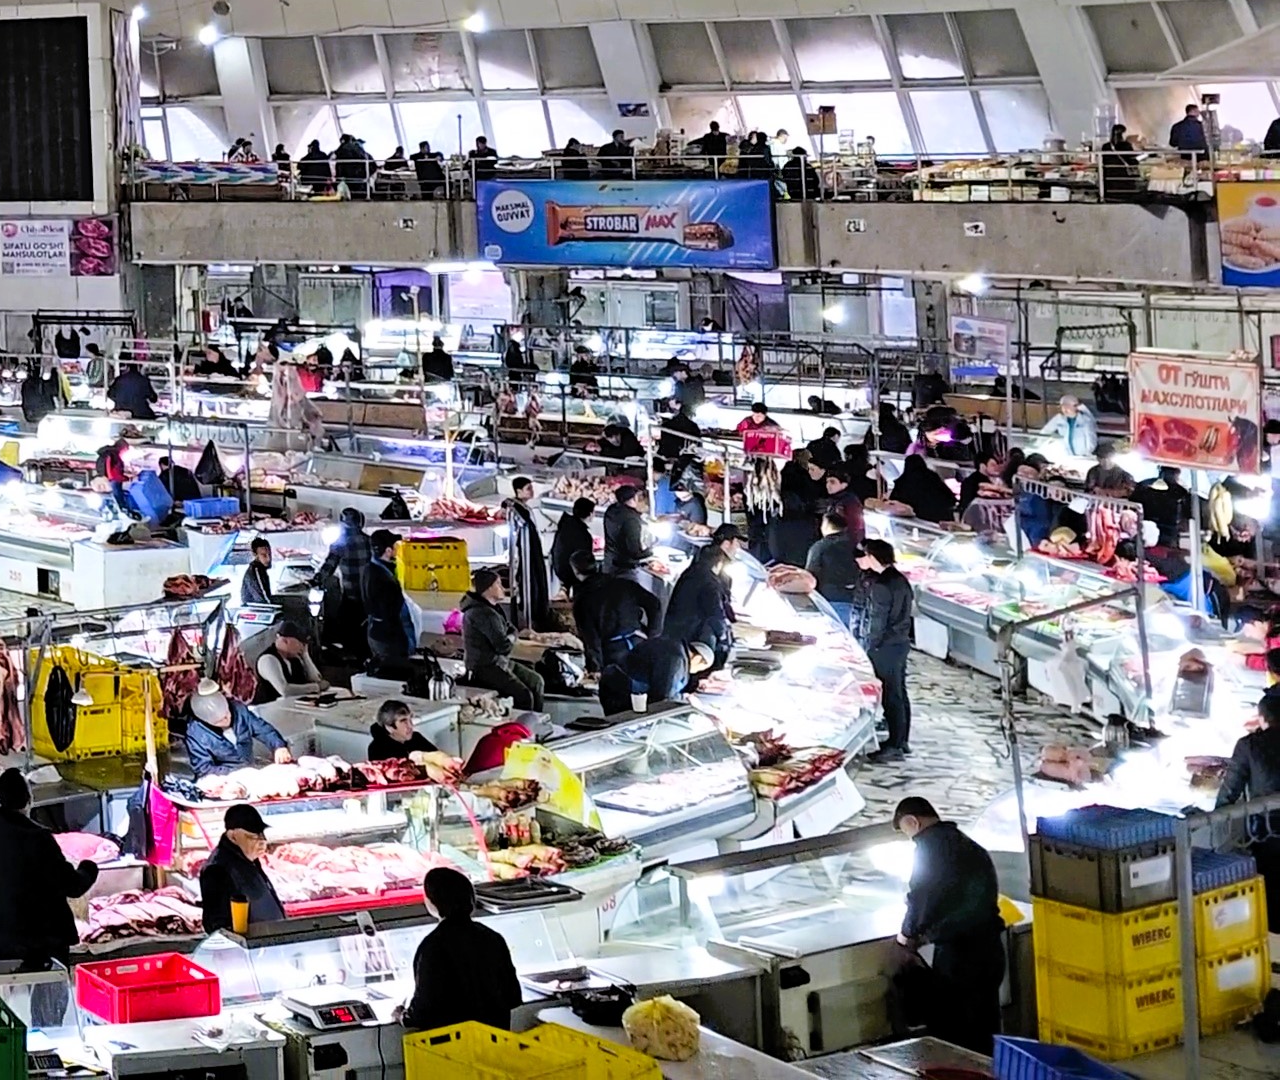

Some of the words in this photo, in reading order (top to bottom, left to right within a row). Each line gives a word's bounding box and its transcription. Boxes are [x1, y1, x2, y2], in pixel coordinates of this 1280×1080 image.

[586, 216, 637, 231] STROBAR
[644, 213, 678, 231] MAX
[2, 251, 67, 259] MAHSULOTLARI
[3, 242, 31, 250] SIFATLI
[1158, 363, 1182, 386] ОТ
[1131, 926, 1171, 947] WIBERG
[1136, 988, 1175, 1009] WIBERG
